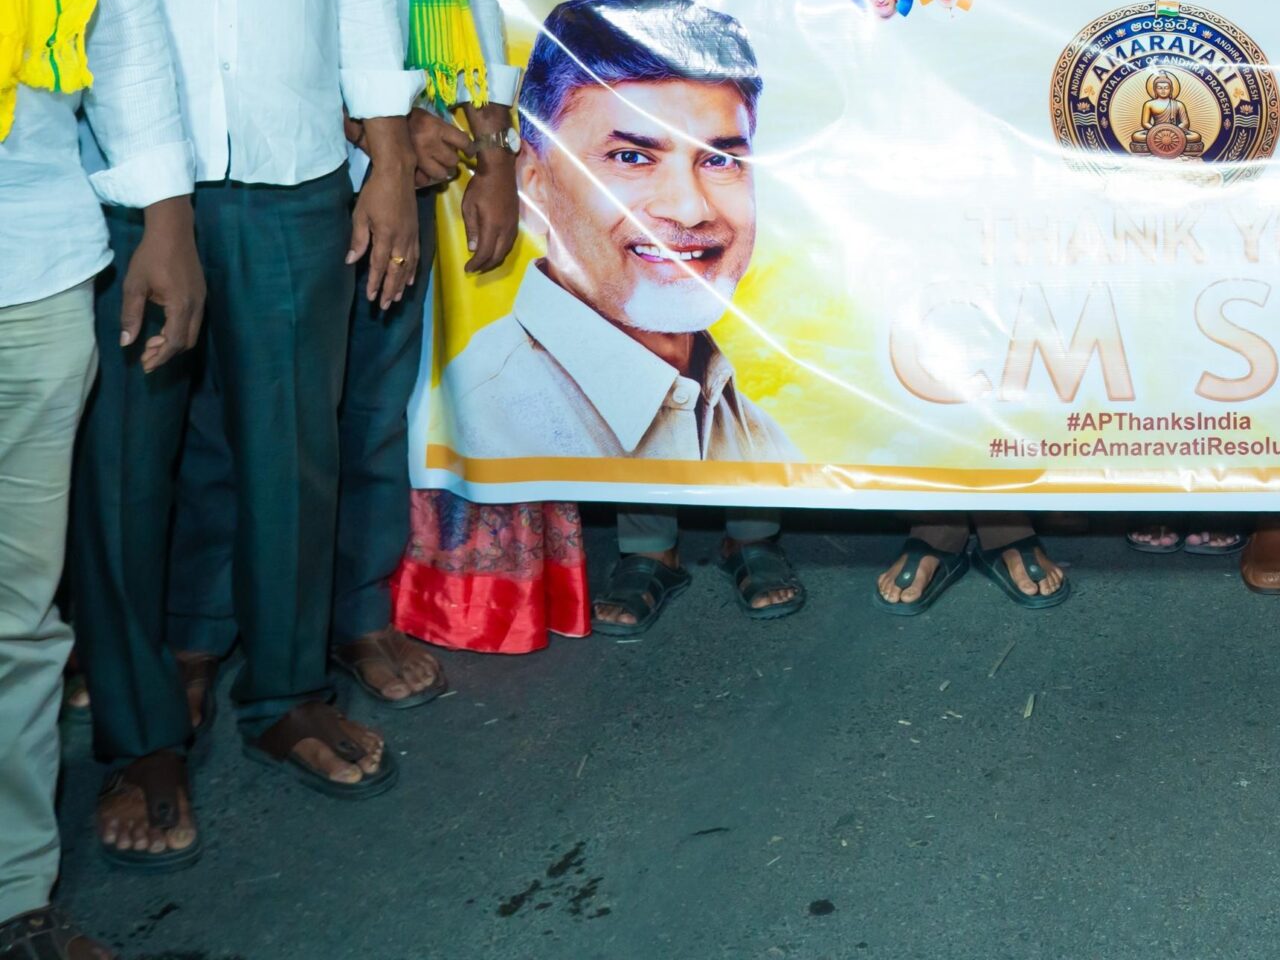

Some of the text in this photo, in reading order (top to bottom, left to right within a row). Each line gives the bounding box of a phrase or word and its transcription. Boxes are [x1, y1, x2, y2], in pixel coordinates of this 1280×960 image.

[1070, 34, 1113, 96] ANDHRA PRADESH
[1092, 35, 1237, 84] AMARAVATI
[1099, 74, 1122, 113] CAPITAL
[1145, 55, 1160, 65] OF
[1162, 55, 1204, 76] ANDHRA
[1205, 75, 1231, 115] PRADESH
[1215, 37, 1259, 100] ANDHRA RADESH
[964, 204, 1204, 265] THANK
[889, 278, 1136, 405] CM
[1067, 412, 1251, 431] #APThanksIndia
